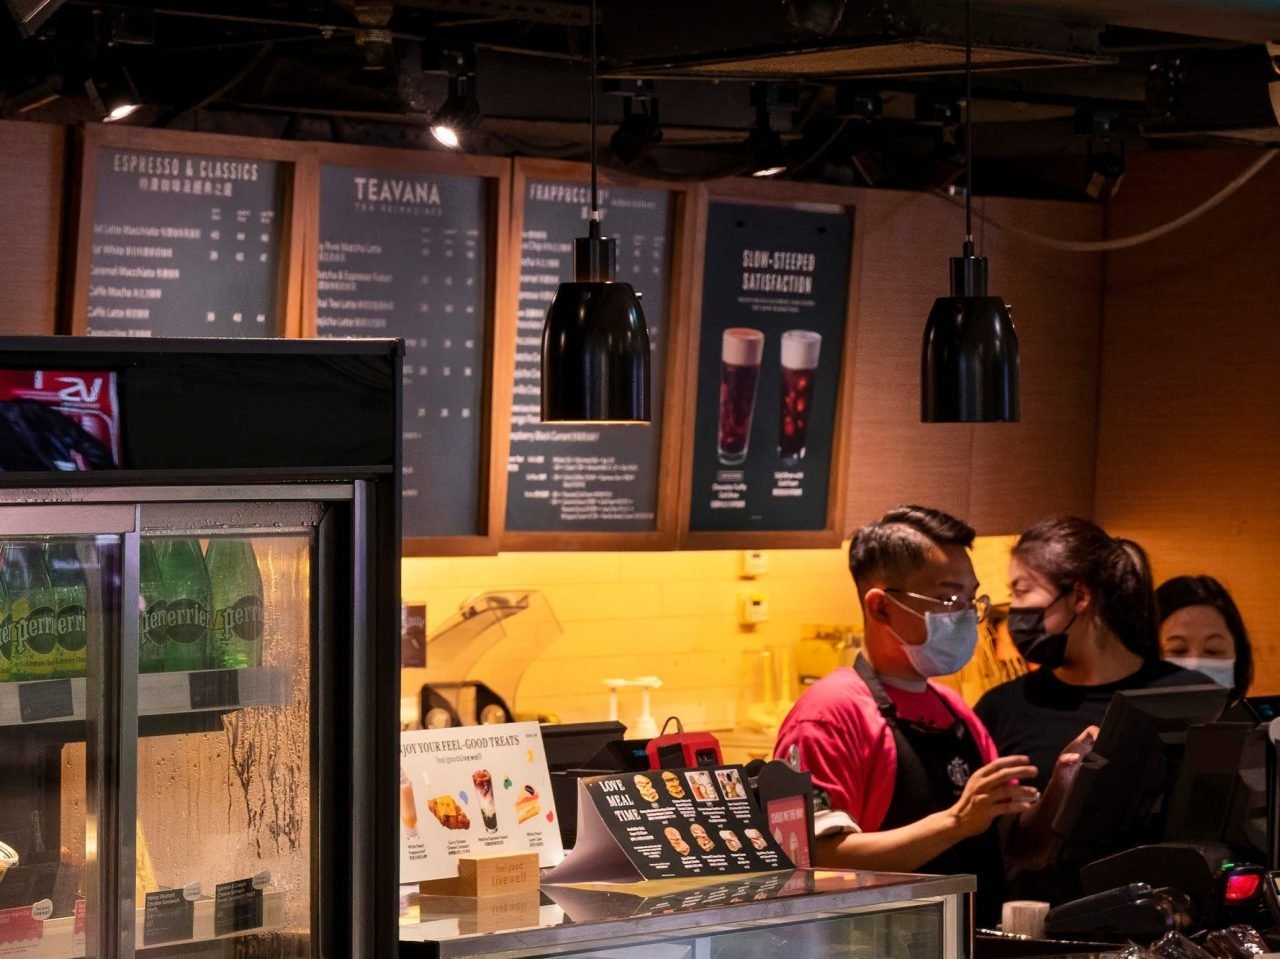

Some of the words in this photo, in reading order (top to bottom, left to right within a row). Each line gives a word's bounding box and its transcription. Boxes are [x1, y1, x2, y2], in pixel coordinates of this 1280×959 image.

[114, 154, 180, 176] ESPRESSO
[185, 159, 194, 177] &
[200, 160, 259, 181] CLASSICS
[354, 177, 440, 205] TEAVANA
[742, 249, 816, 271] SLOW-STEEPED
[742, 272, 812, 293] SATISFACTION
[400, 743, 417, 757] JOY
[418, 741, 441, 753] YOUR
[442, 738, 488, 751] FEEL-GOOD
[489, 735, 520, 748] TREATS
[598, 779, 626, 793] LOVE
[606, 794, 635, 807] MEAL
[614, 809, 642, 822] TIME
